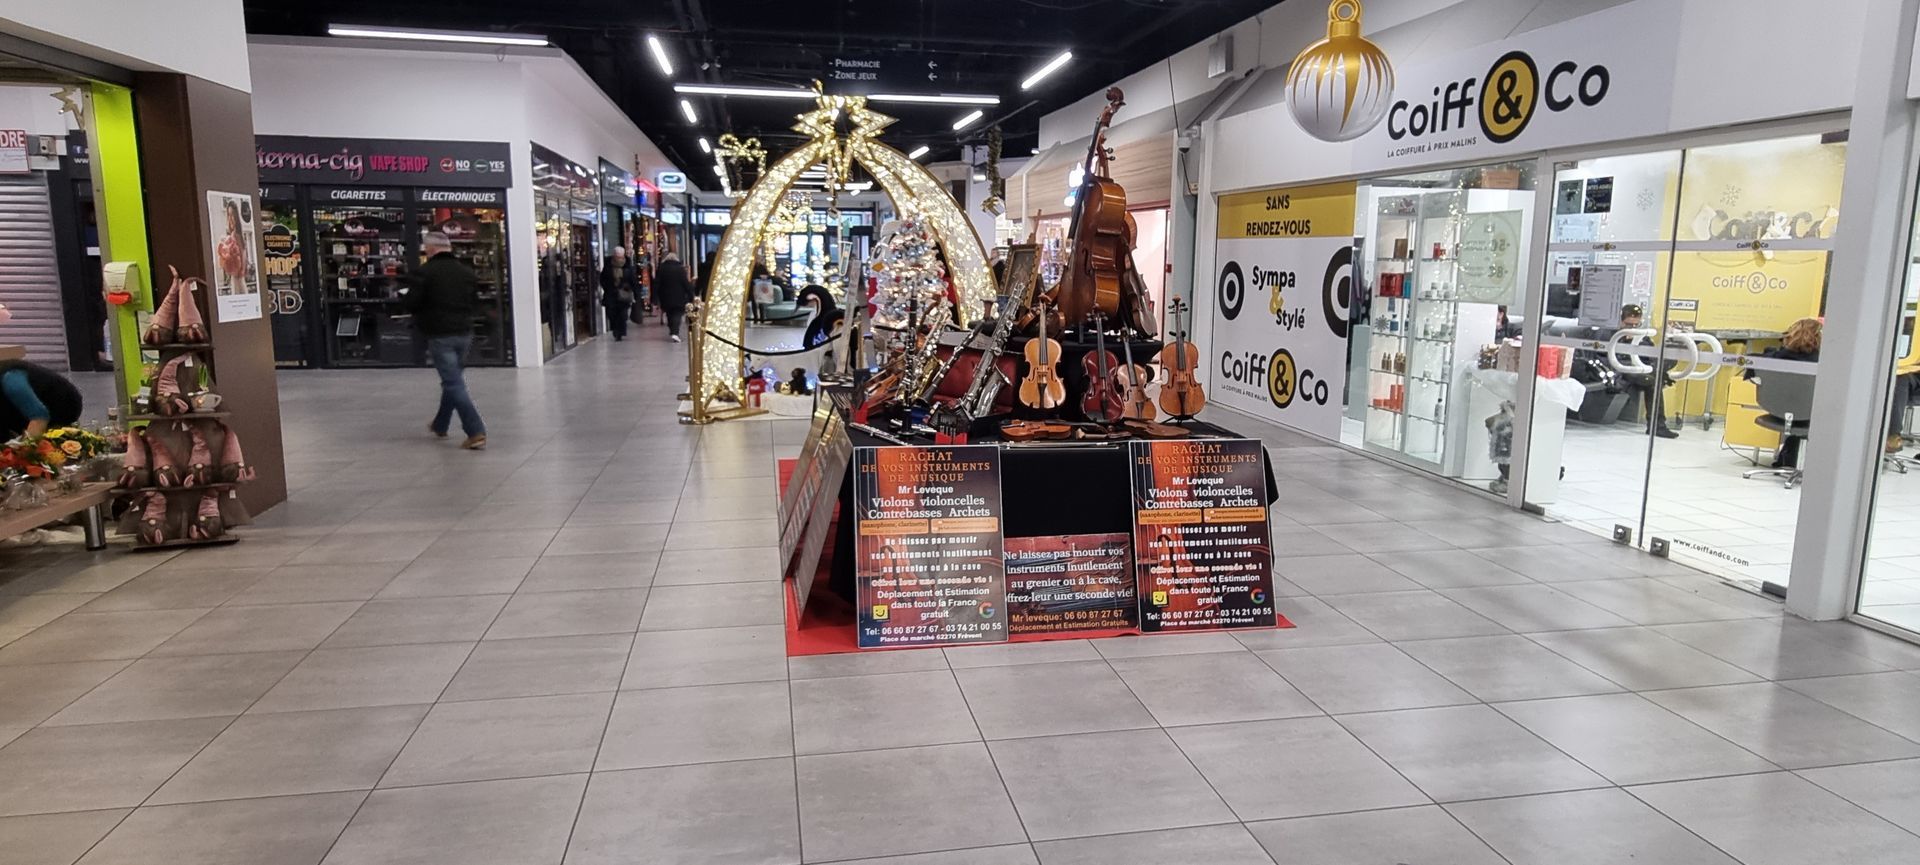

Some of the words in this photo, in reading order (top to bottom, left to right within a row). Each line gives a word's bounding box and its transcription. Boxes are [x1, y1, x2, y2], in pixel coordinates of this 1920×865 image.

[1388, 78, 1476, 140] Coiff
[1545, 60, 1610, 112] Co
[1396, 145, 1425, 156] COIFFURE
[1434, 142, 1448, 150] PRIX
[1451, 137, 1476, 148] MALINS
[369, 155, 398, 171] VAPE
[399, 156, 429, 172] SHOP
[456, 160, 470, 168] NO
[330, 190, 386, 200] CIGARETTES
[422, 190, 496, 202] ÉLECTRONIQUES
[1266, 194, 1290, 211] SANS
[1246, 219, 1311, 236] RENDEZ-VOUS
[1252, 266, 1296, 292] Sympa
[1712, 276, 1746, 288] Coiff
[1769, 279, 1787, 289] Co
[1276, 308, 1305, 331] Stylé
[1222, 351, 1266, 387] Coiff
[1299, 369, 1328, 405] Co
[1172, 444, 1222, 454] RACHAT
[900, 452, 952, 461] RACHAT
[1157, 456, 1177, 464] VOS
[1182, 454, 1257, 463] INSTRUMENTS
[883, 464, 904, 472] VOS
[909, 462, 990, 472] INSTRUMENTS
[1163, 466, 1178, 474] DE
[1182, 465, 1233, 474] MUSIQUE
[889, 474, 904, 482] DE
[911, 473, 964, 483] MUSIQUE
[1172, 477, 1184, 485] Mr
[1187, 477, 1224, 486] Leveque
[898, 486, 910, 494] Mr
[914, 486, 954, 495] Leveque
[1148, 487, 1188, 498] Violons
[1193, 485, 1253, 497] violoncelles
[872, 497, 914, 507] Violons
[920, 495, 985, 506] violoncelles
[1145, 498, 1214, 510] Contrebasses
[1220, 497, 1258, 508] Archets
[868, 508, 942, 519] Contrebasses
[949, 506, 990, 517] Archets
[1020, 551, 1051, 559] laissez
[1054, 551, 1070, 560] pas
[1073, 548, 1106, 557] mourir
[1109, 548, 1124, 556] vos
[1673, 538, 1749, 566] www.coiffandco.com
[1007, 564, 1065, 574] instruments
[1068, 562, 1123, 572] inutilement
[1026, 578, 1060, 589] grenier
[1063, 578, 1076, 586] ou
[1078, 576, 1085, 585] à
[1087, 575, 1095, 585] la
[1098, 576, 1121, 584] cave,
[1157, 576, 1208, 586] Déplacement
[1219, 574, 1260, 582] Estimation
[877, 590, 933, 600] Déplacement
[945, 587, 989, 596] Estimation
[1054, 592, 1072, 600] une
[1075, 589, 1115, 599] seconde
[1170, 587, 1189, 595] dans
[1191, 586, 1212, 594] toute
[1213, 585, 1220, 593] la
[891, 600, 912, 609] dans
[914, 600, 936, 608] toute
[939, 599, 946, 607] la
[948, 598, 977, 606] France
[1197, 596, 1223, 606] gratuit
[920, 610, 949, 620] gratuit
[1077, 611, 1087, 619] 60
[1101, 610, 1111, 618] 27
[1146, 612, 1160, 620] Tel:
[1184, 610, 1192, 618] 87
[1194, 610, 1203, 618] 27
[1205, 609, 1214, 617] 67
[1220, 609, 1229, 617] 03
[1231, 608, 1240, 616] 74
[1242, 608, 1250, 616] 21
[1263, 607, 1272, 615] 55
[865, 627, 880, 636] Tel:
[882, 627, 892, 635] 06
[893, 626, 903, 634] 60
[917, 625, 926, 633] 27
[929, 624, 938, 632] 67
[946, 624, 956, 632] 03
[958, 623, 966, 631] 74
[968, 623, 978, 631] 21
[980, 622, 990, 630] 00
[992, 622, 1002, 630] 55
[1009, 624, 1053, 632] Déplacement
